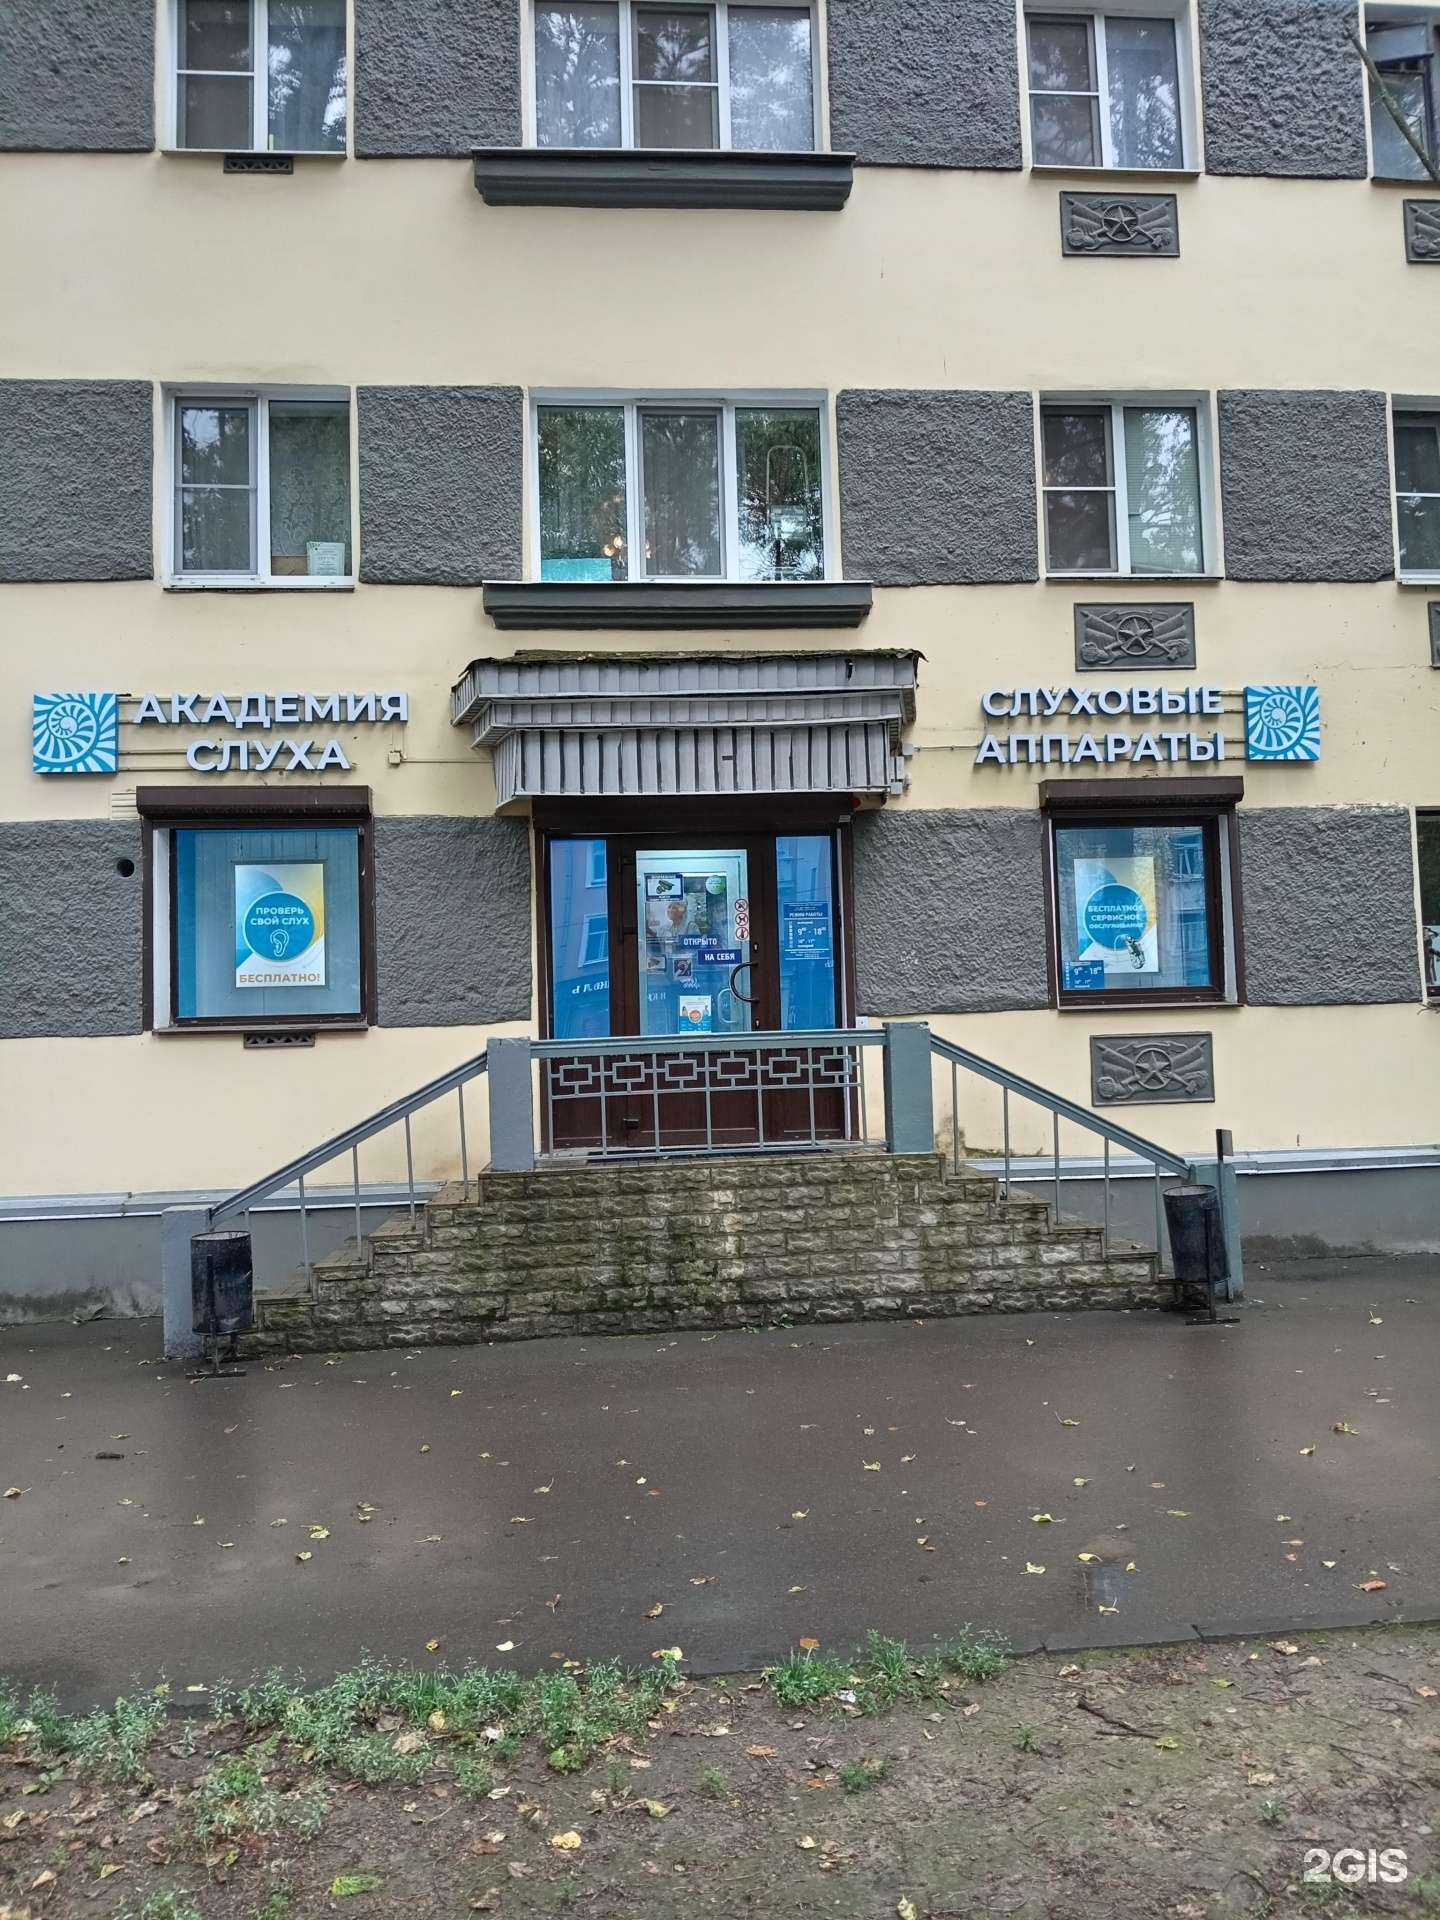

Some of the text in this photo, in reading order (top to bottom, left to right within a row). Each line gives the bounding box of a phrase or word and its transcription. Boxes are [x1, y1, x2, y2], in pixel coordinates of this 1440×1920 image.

[133, 692, 409, 729] АКАДЕМИЯ
[981, 686, 1225, 716] СЛУХОВЫЕ
[186, 739, 351, 771] СЛУХА
[974, 732, 1225, 764] АППАРАТЫ
[255, 907, 304, 915] ПРОВЕРЬ
[250, 917, 310, 926] СВОЙ СЛУХ
[683, 938, 718, 946] ОТКРЫТО
[704, 953, 735, 961] НА СЕБЯ
